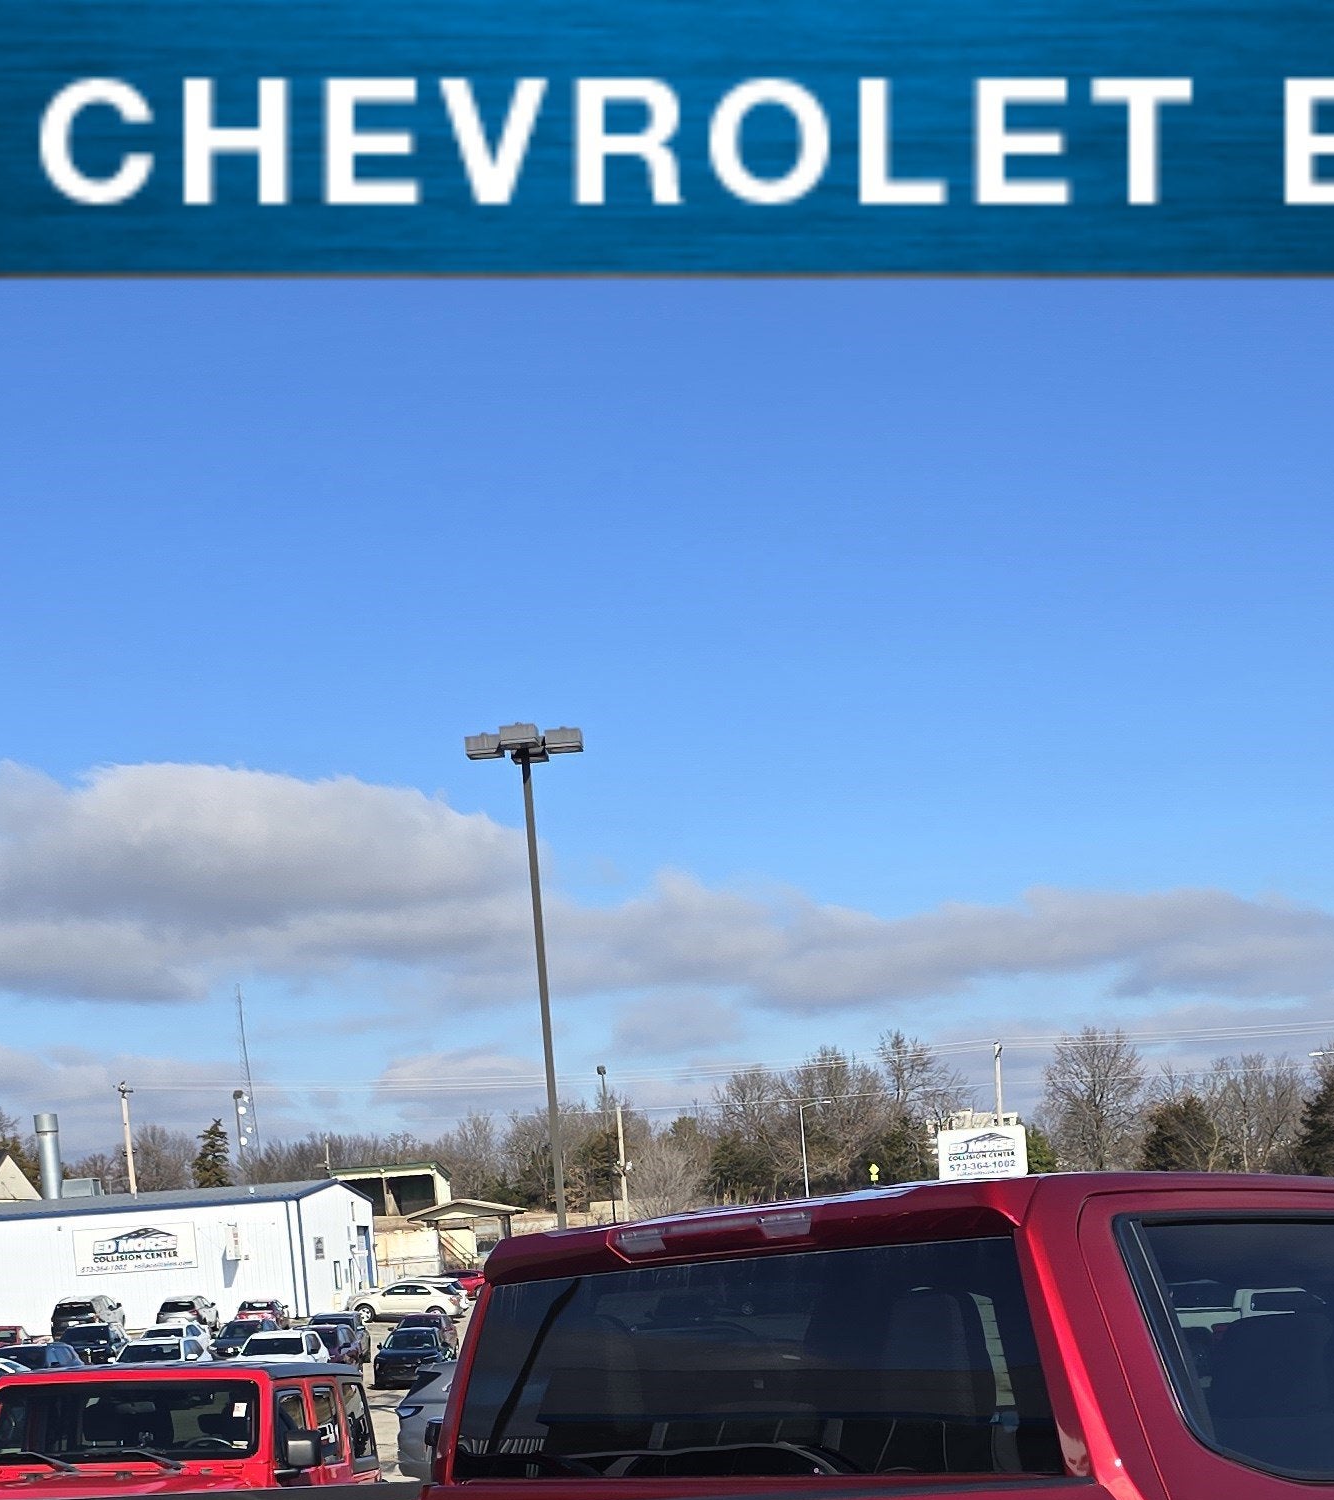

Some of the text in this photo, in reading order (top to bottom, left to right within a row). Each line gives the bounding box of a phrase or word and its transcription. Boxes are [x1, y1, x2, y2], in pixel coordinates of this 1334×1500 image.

[948, 1150, 1015, 1161] COLLISION CENTER
[93, 1235, 178, 1256] ED MORSE
[93, 1250, 179, 1263] COLLISION CENTER
